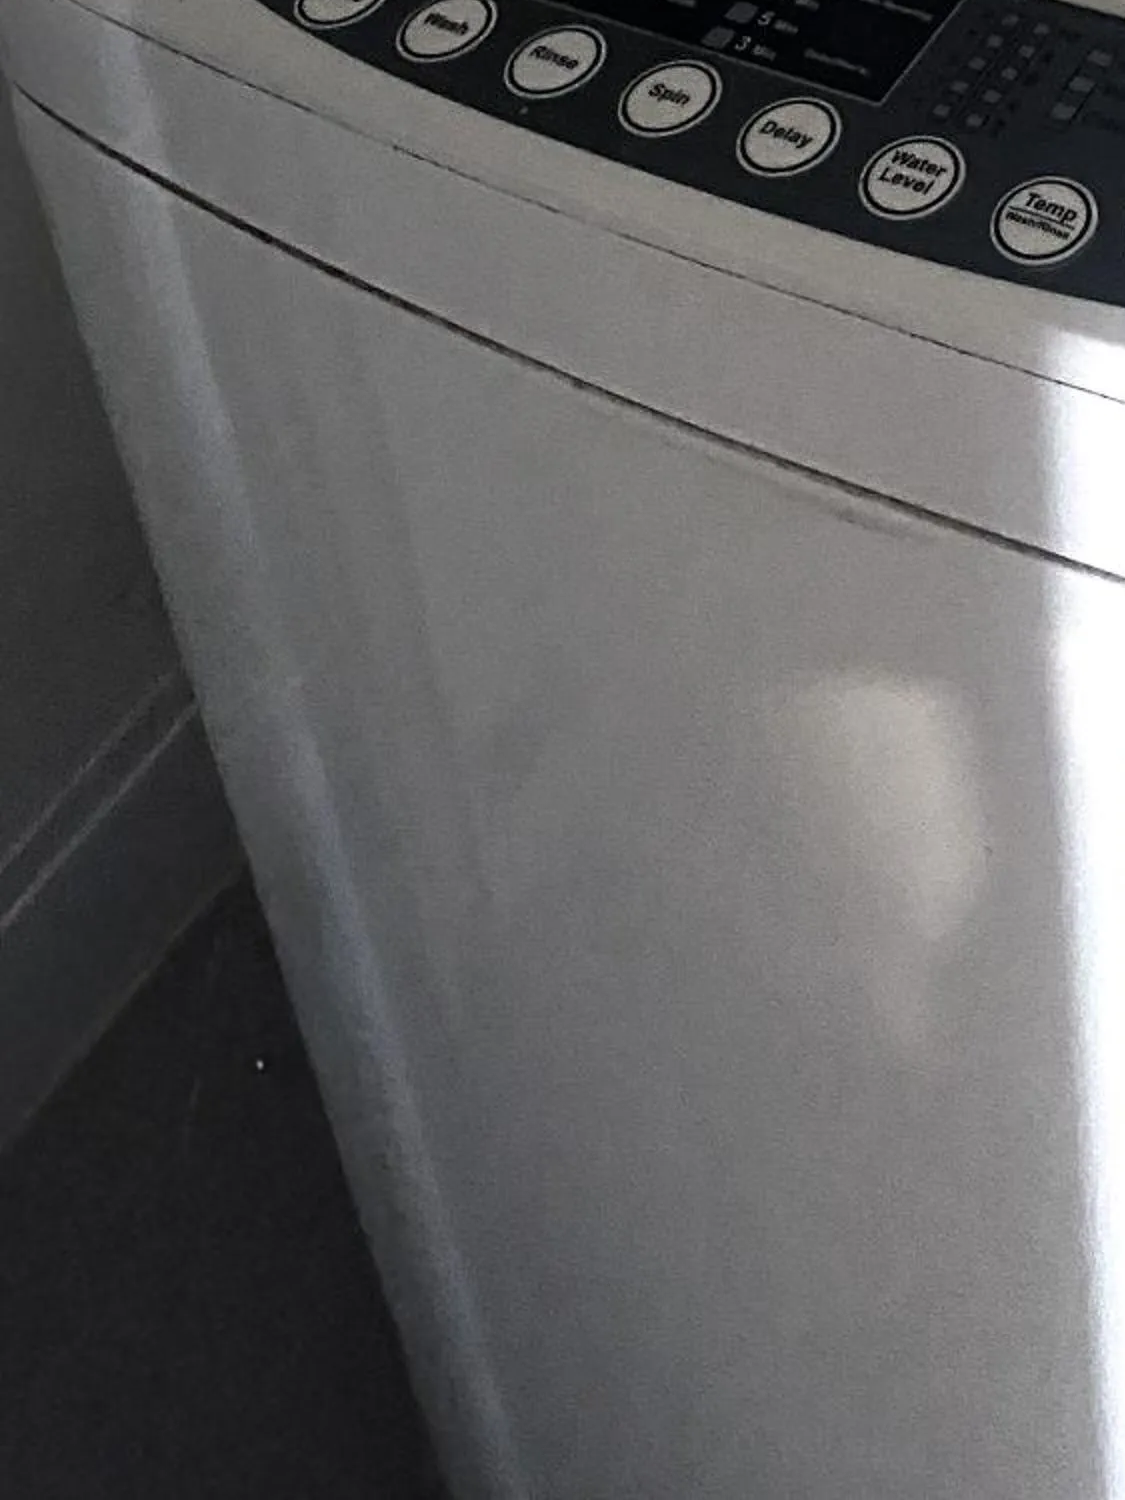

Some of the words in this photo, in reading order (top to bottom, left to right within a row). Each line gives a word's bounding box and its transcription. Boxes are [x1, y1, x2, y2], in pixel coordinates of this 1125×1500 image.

[423, 11, 470, 37] Wash
[528, 44, 579, 71] Rinse
[647, 82, 691, 107] Spin
[758, 119, 814, 150] Delay
[891, 149, 948, 179] Water
[878, 169, 934, 196] Level
[1024, 191, 1077, 226] Temp
